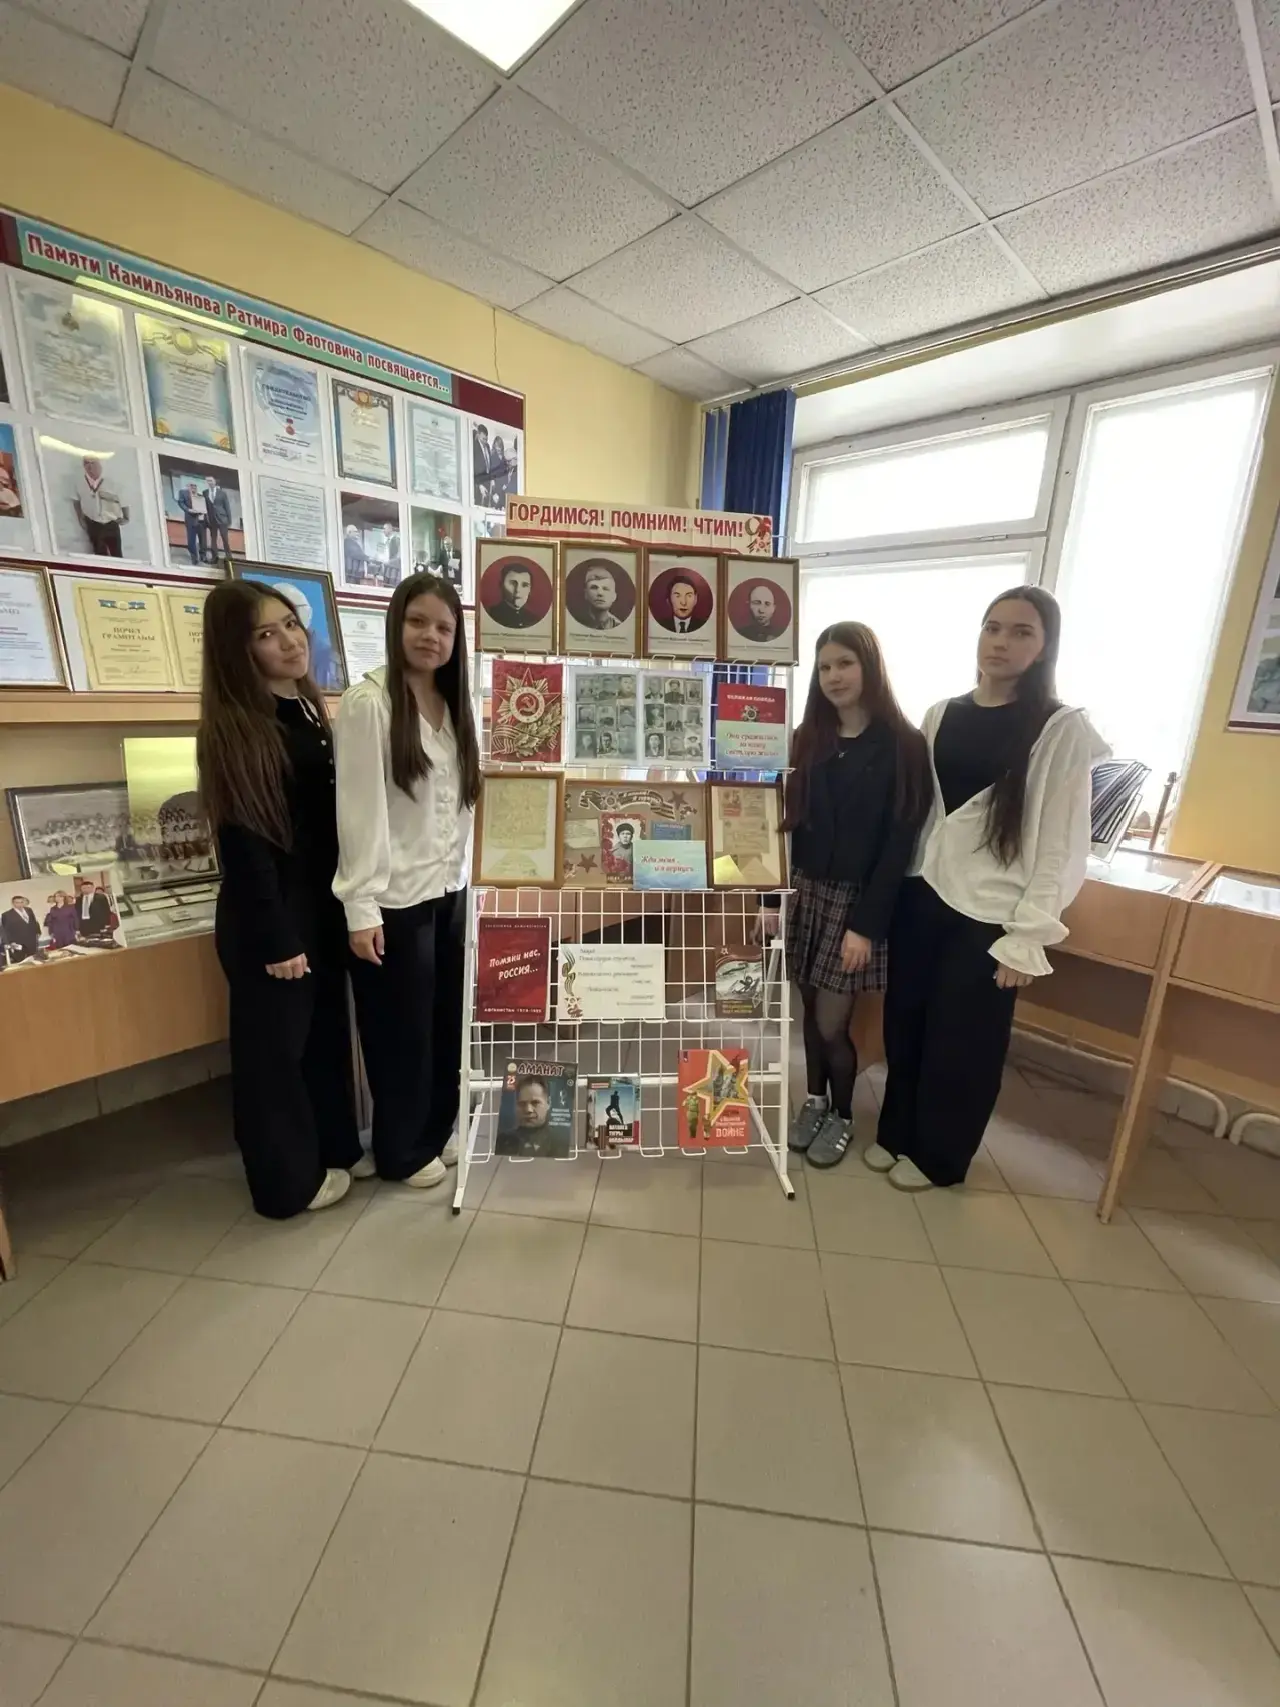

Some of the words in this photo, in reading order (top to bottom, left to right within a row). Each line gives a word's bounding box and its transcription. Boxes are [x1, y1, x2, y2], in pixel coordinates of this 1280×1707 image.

[27, 232, 101, 275] Памяти
[107, 261, 221, 316] Камильянова
[226, 303, 288, 338] Ратмира
[292, 326, 363, 364] Фаотовича
[367, 353, 450, 393] посвящается...
[509, 502, 604, 527] ГОРДИМСЯ!
[611, 510, 687, 533] ПОМНИМ!
[693, 518, 744, 538] ЧТИМ!
[489, 954, 521, 968] Помяни
[498, 964, 539, 981] РОССИЯ...
[517, 1063, 565, 1076] АМАНАТ
[715, 1126, 745, 1138] ВОЙНЕ
